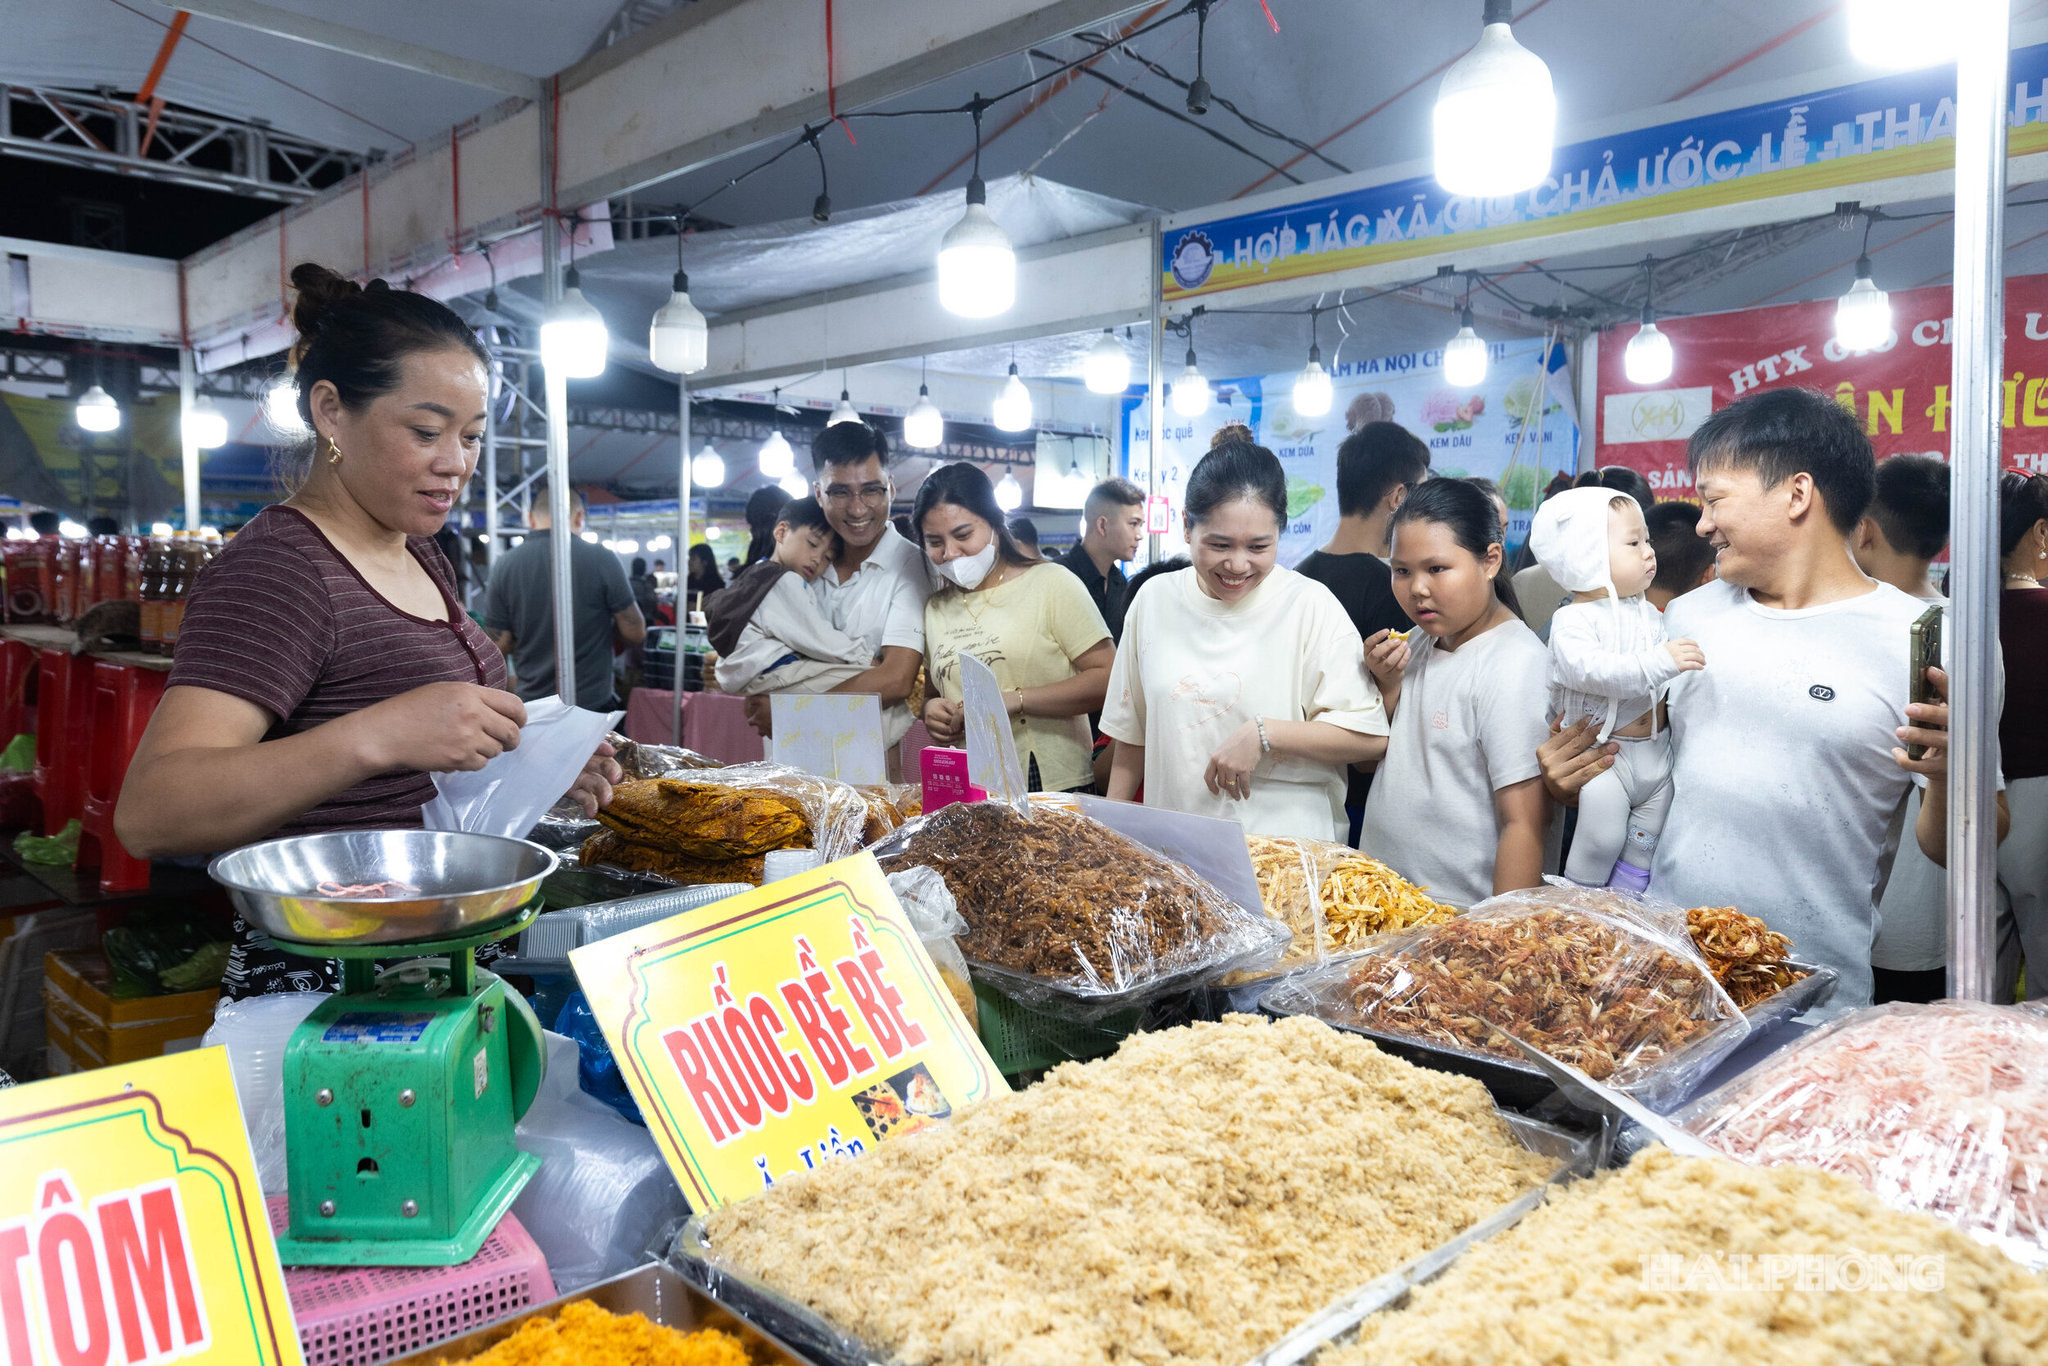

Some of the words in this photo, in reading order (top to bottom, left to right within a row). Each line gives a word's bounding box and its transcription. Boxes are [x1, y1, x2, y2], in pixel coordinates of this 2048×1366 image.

[1233, 226, 1297, 274] HỢP
[1306, 209, 1371, 255] TÁC
[1382, 194, 1430, 243] XÃ
[1529, 150, 1622, 215] CHẢ
[1638, 136, 1742, 197] ƯỚC
[1761, 105, 1809, 173] LỄ
[1855, 78, 2048, 156] THAH
[1728, 345, 1813, 395] HTX
[1171, 466, 1178, 481] 2
[1648, 462, 1692, 488] SẢN
[662, 966, 814, 1144] RUỐC
[781, 938, 875, 1086] BỀ
[836, 917, 929, 1059] BỀ
